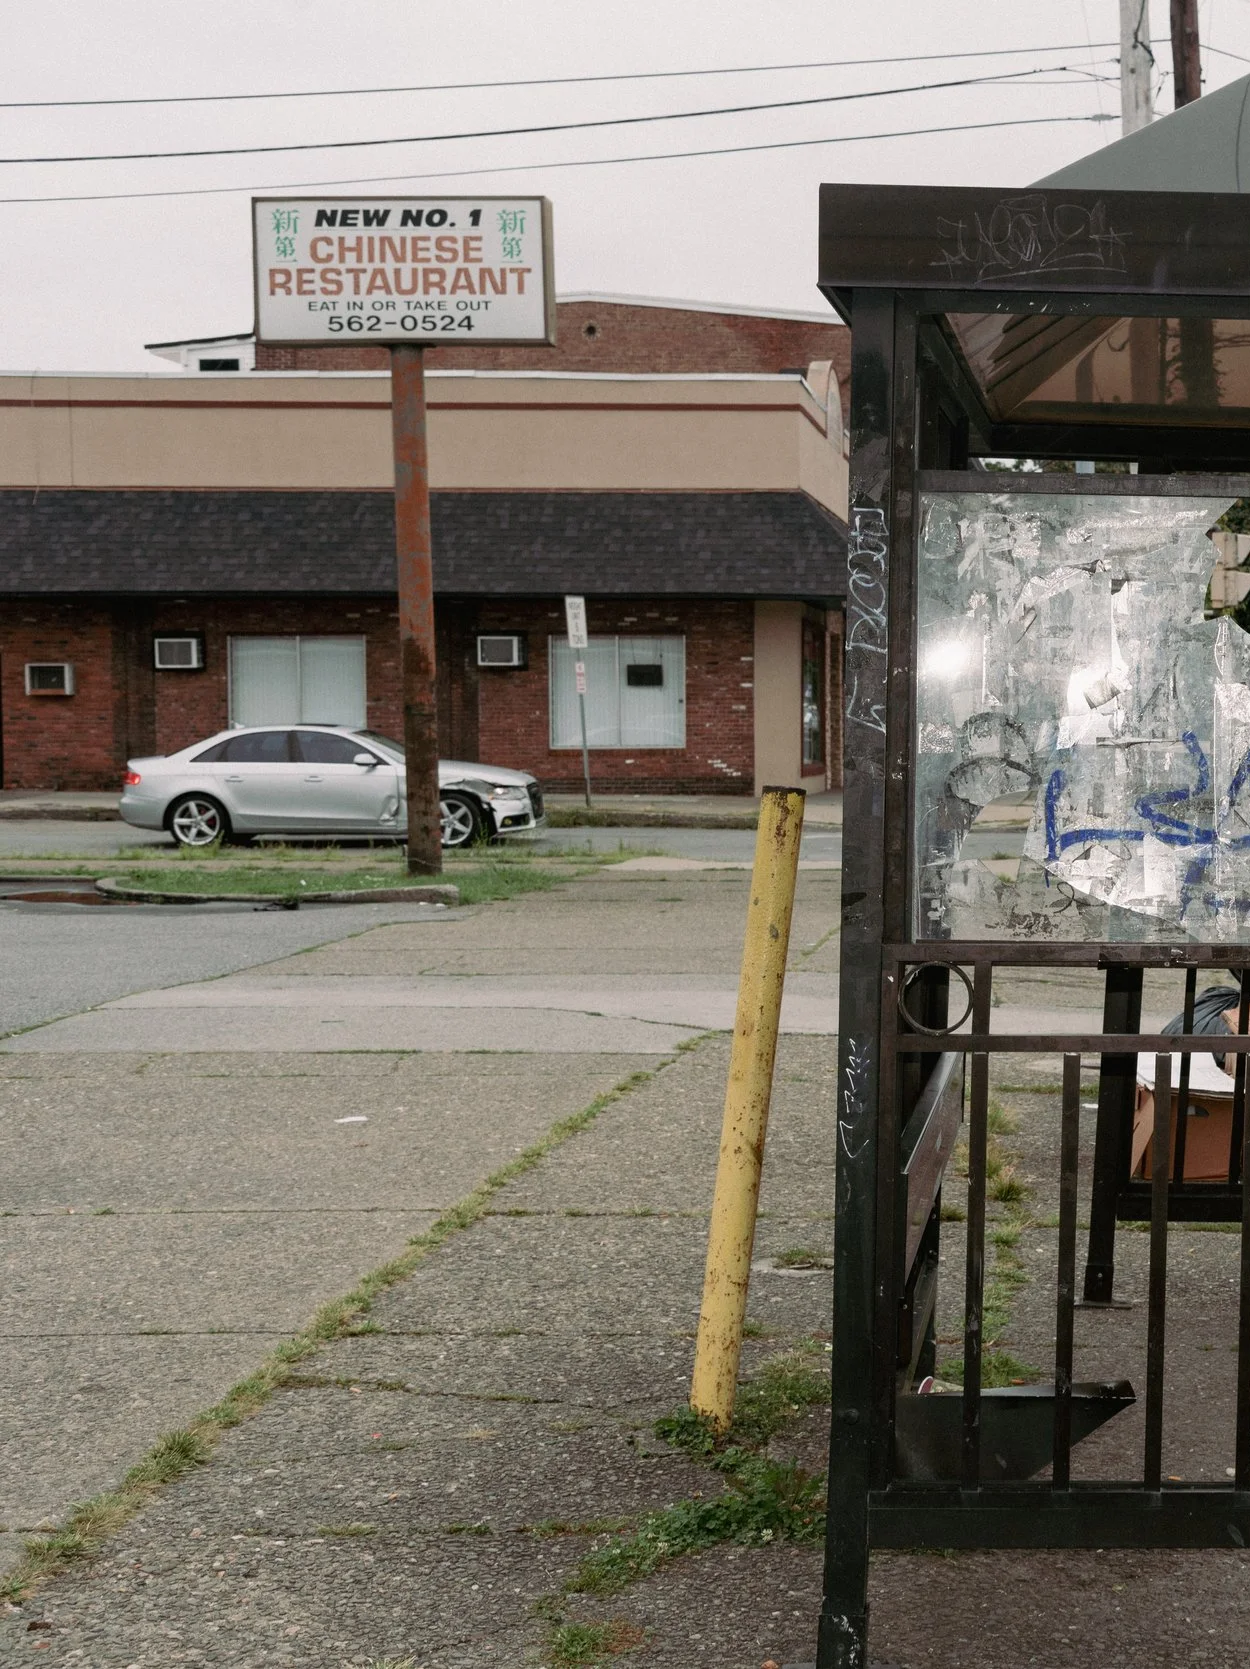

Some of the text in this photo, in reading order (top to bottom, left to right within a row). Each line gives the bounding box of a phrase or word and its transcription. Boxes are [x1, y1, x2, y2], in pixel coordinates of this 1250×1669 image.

[314, 208, 482, 228] NEW NO. 1
[309, 235, 484, 265] CHINESE
[268, 267, 532, 297] RESTAURANT
[308, 300, 492, 312] EAT IN OR TAKE OUT
[327, 315, 475, 332] 562-0524
